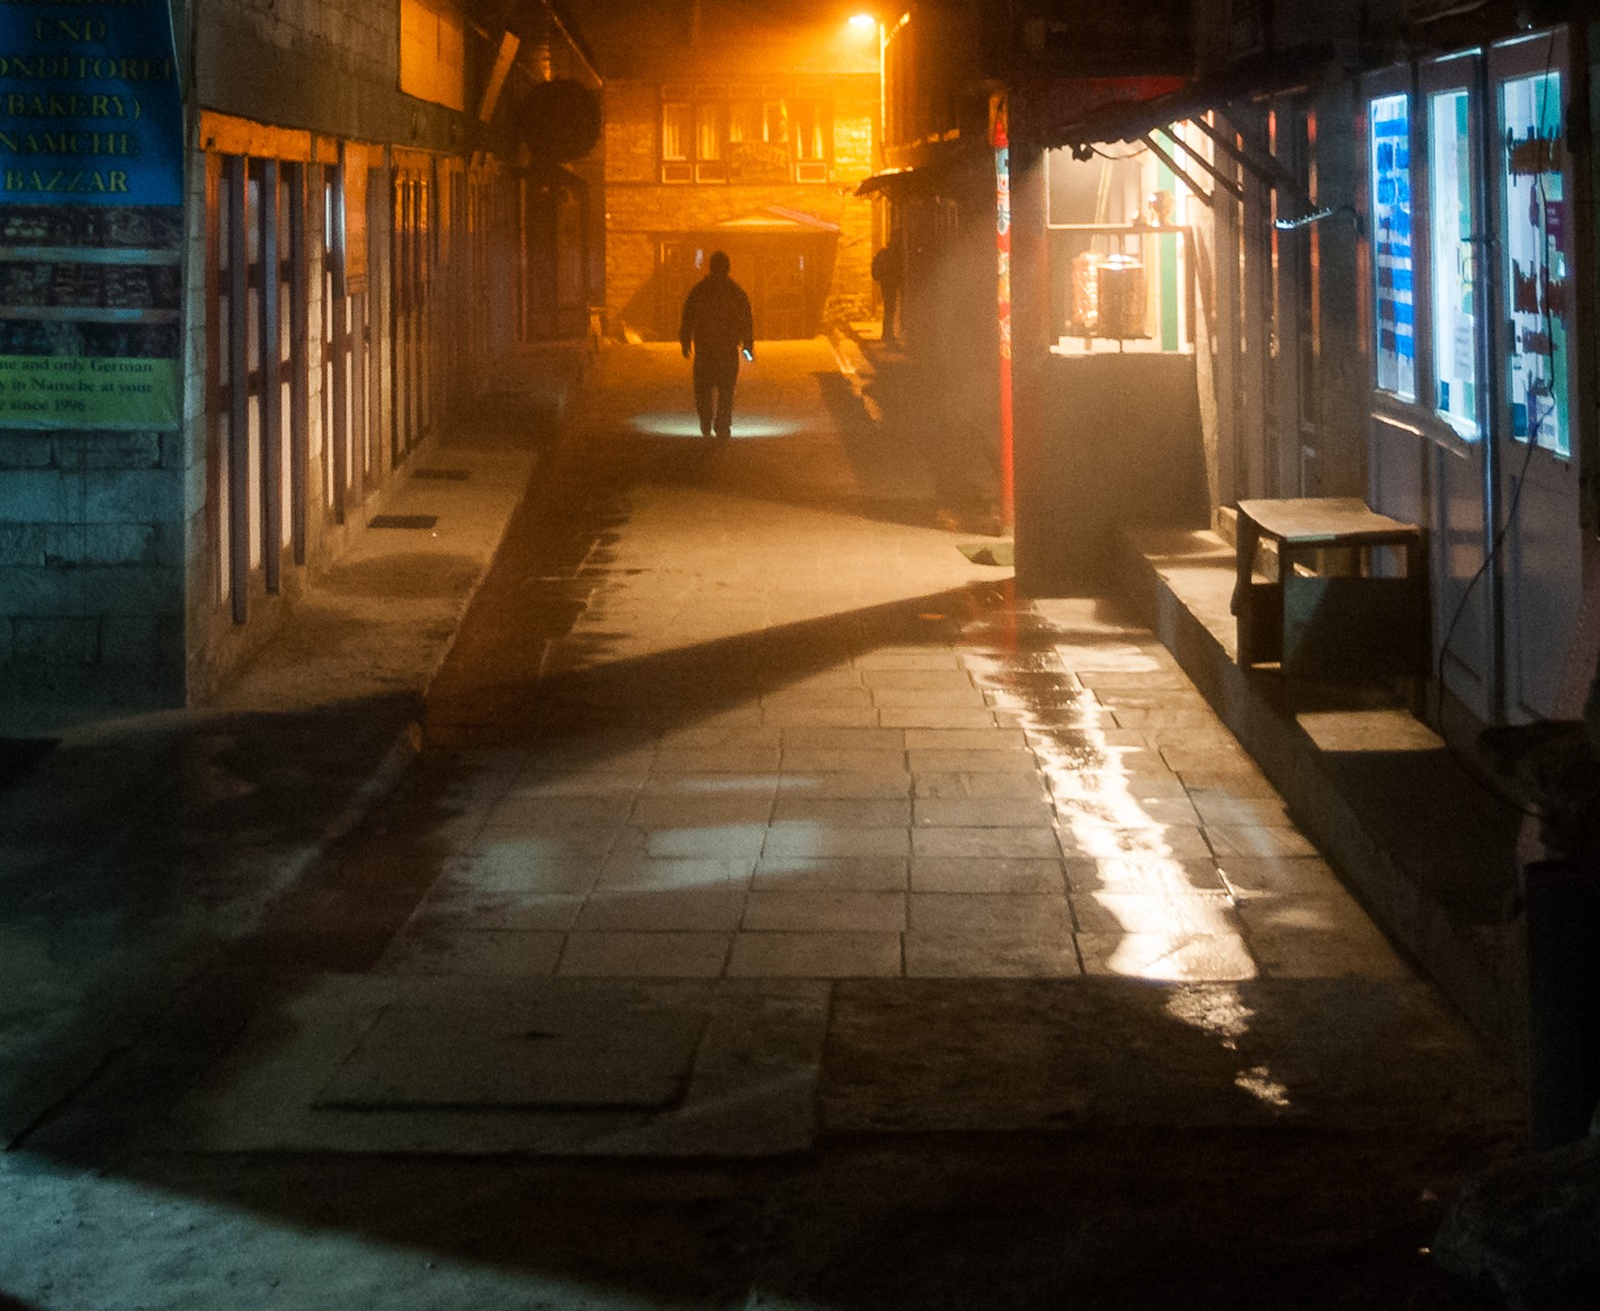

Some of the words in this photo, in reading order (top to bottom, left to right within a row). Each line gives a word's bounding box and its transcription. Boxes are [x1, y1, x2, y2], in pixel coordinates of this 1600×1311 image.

[34, 19, 107, 41] UND
[0, 132, 140, 155] NAMCHE
[5, 170, 128, 192] BAZZAR
[22, 358, 50, 371] and
[54, 359, 84, 374] only
[91, 359, 153, 373] German
[31, 377, 93, 392] Namche
